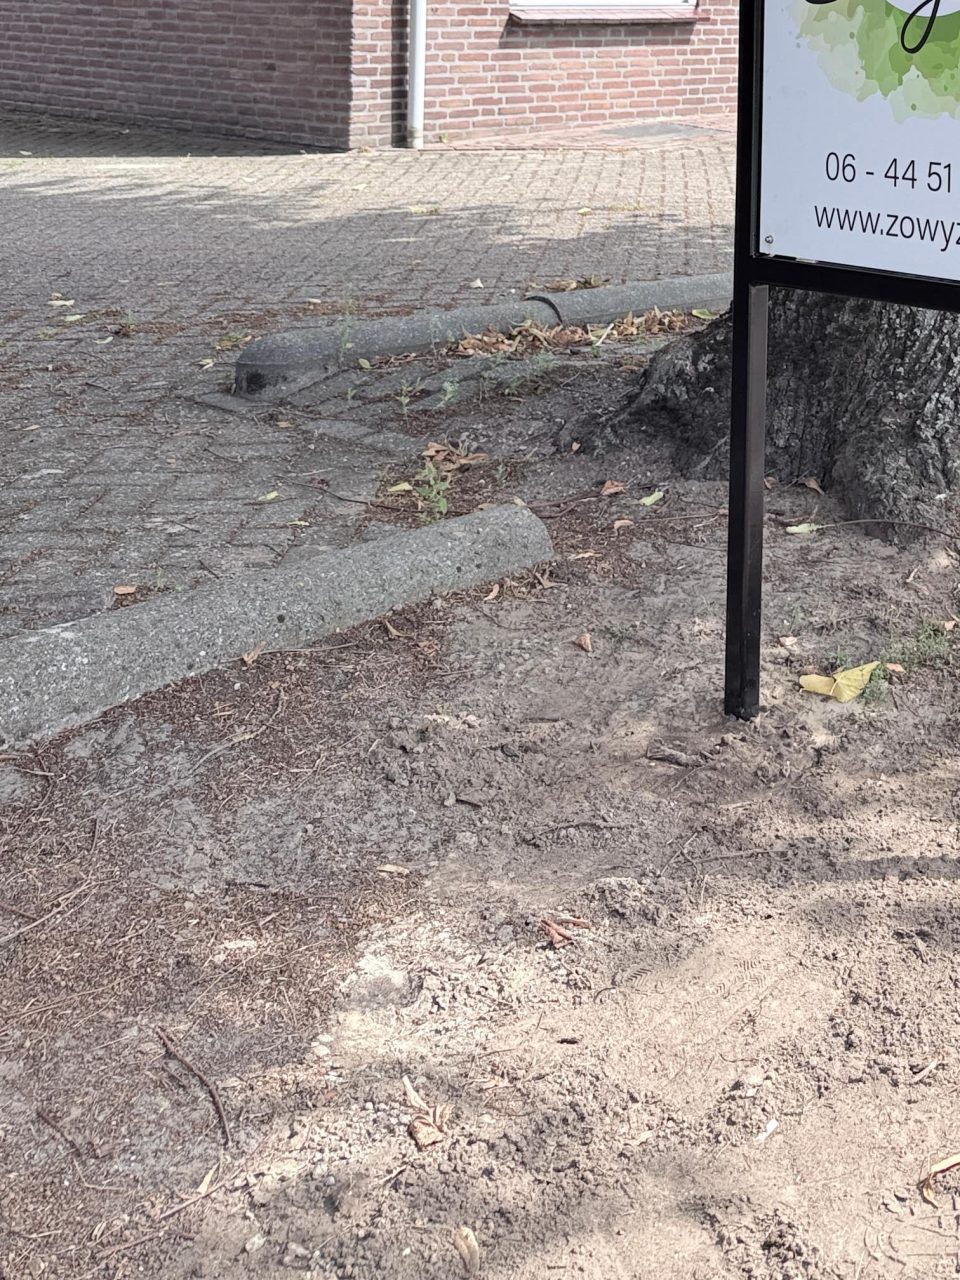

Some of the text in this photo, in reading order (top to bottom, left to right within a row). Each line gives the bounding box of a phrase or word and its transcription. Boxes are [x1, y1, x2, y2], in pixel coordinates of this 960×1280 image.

[825, 152, 856, 183] 06
[884, 157, 917, 189] 44
[927, 161, 952, 193] 51
